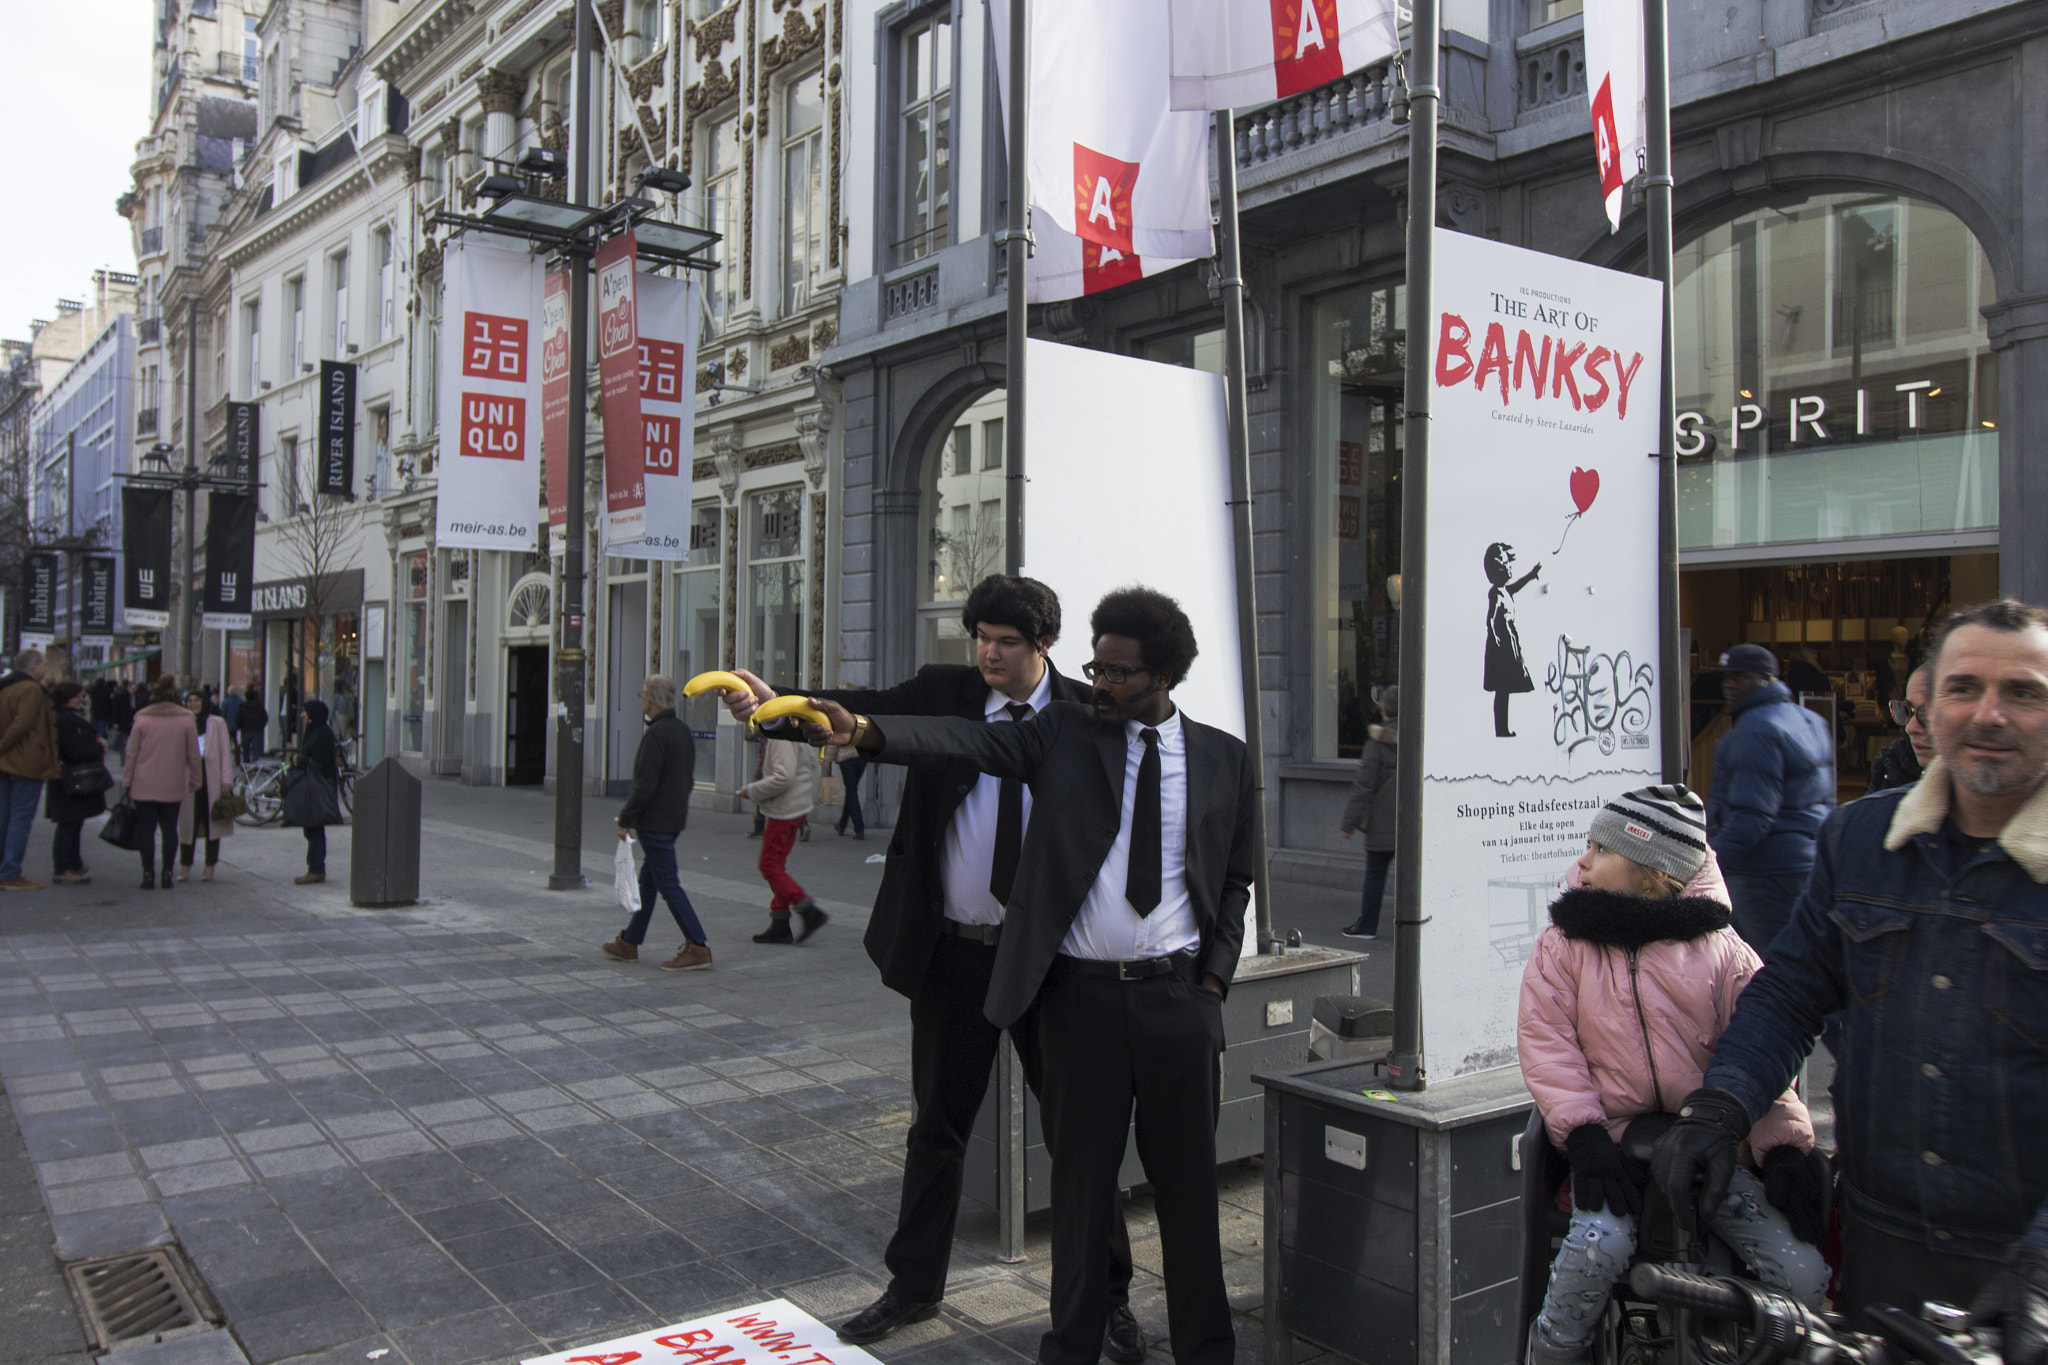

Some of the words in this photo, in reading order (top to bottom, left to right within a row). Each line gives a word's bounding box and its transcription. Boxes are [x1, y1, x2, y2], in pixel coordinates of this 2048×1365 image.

[1531, 289, 1571, 305] PRODUCTIONS
[1490, 292, 1527, 319] THE
[1533, 304, 1569, 329] ART
[1575, 311, 1599, 333] OF
[1435, 312, 1644, 421] BANKSY
[331, 369, 346, 431] ISLAND
[469, 401, 515, 426] UNI
[1491, 409, 1523, 424] Curated
[1525, 416, 1534, 428] by
[1537, 416, 1557, 430] Steve
[1559, 420, 1594, 435] Lazarides
[1675, 380, 1932, 456] SPRIT
[468, 428, 518, 454] QLO
[641, 421, 669, 443] NI
[329, 438, 343, 487] RIVER
[449, 520, 527, 538] meir-as.be
[139, 567, 154, 599] WE
[221, 571, 236, 602] WE
[264, 585, 307, 610] ISLAND
[1457, 802, 1515, 819] Shopping
[1518, 796, 1600, 814] Stadsfeestzaal
[1520, 821, 1537, 831] Elke
[1540, 820, 1554, 831] dag
[1556, 819, 1574, 830] open
[1482, 838, 1497, 847] van
[1500, 838, 1508, 848] 14
[1510, 833, 1541, 846] januari
[1543, 833, 1554, 842] tot
[1557, 834, 1565, 842] 19
[1501, 853, 1530, 864] Tickets:
